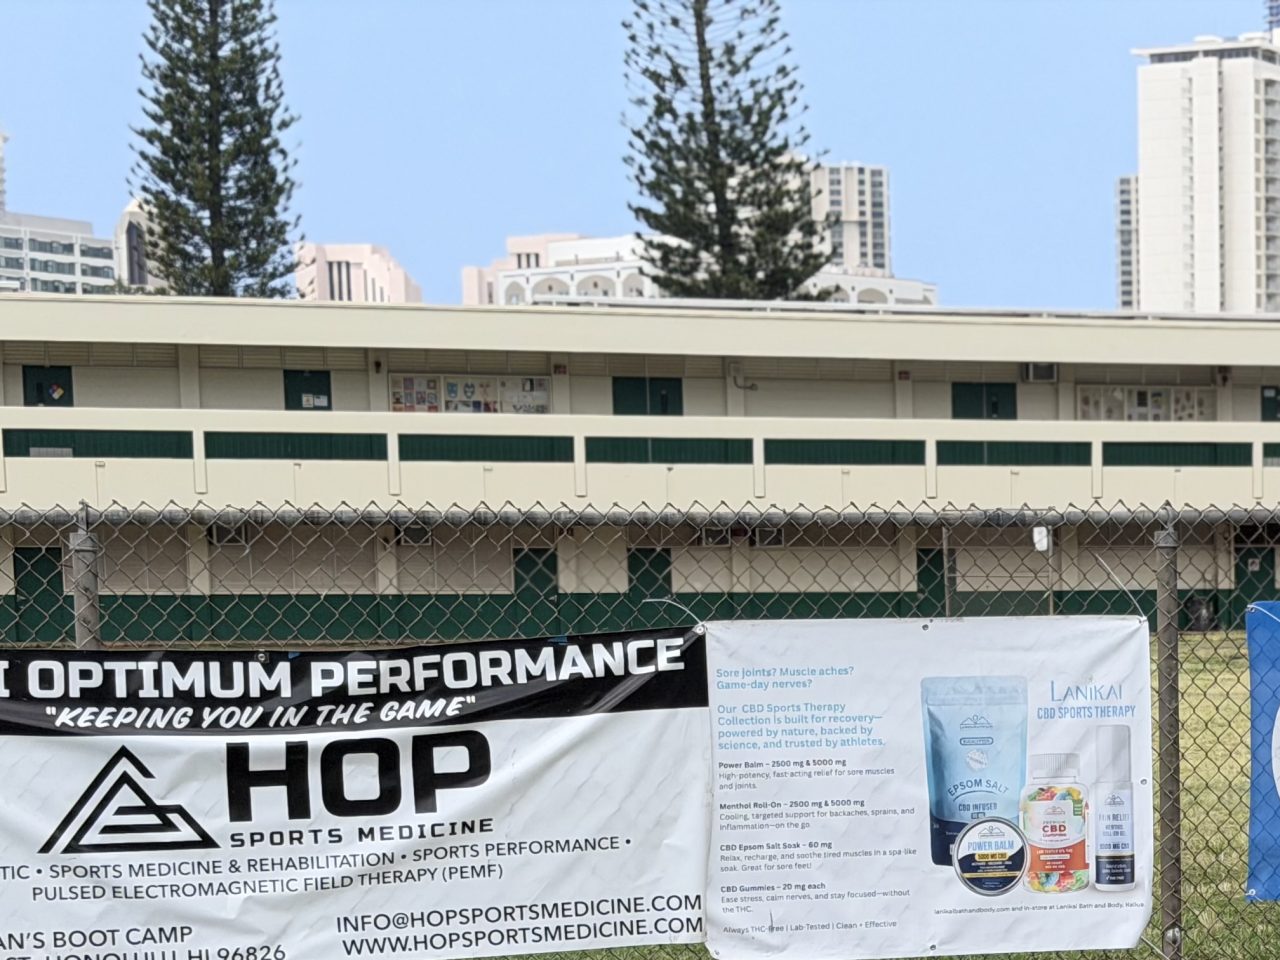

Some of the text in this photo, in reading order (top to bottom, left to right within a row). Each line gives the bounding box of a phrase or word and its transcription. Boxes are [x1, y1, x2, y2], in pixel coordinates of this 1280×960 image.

[27, 661, 292, 699] OPTIMUM
[310, 637, 685, 697] PERFORMANCE
[716, 666, 854, 679] Sore joints? Muscle aches?
[717, 679, 813, 691] Game-day nerves?
[201, 706, 263, 729] YOU
[269, 705, 309, 727] IN
[317, 701, 374, 725] THE
[717, 703, 846, 714] Our CBD Sports Therapy
[1037, 705, 1136, 720] CBD SPORTS THERAPY
[718, 716, 771, 726] Collection
[774, 715, 782, 724] is
[785, 714, 808, 724] built
[811, 714, 827, 723] for
[718, 725, 873, 740] powered by nature, backed by
[718, 741, 761, 750] science,
[763, 739, 782, 749] and
[785, 738, 822, 748] trusted
[826, 738, 838, 749] by
[745, 761, 764, 769] Balm
[772, 760, 791, 768] 2500
[225, 729, 491, 823] HOP
[948, 779, 1009, 797] EPSOM SALT
[752, 812, 783, 820] targeted
[785, 811, 815, 819] support
[230, 818, 494, 849] SPORTS MEDICINE
[1042, 825, 1066, 833] CBD
[739, 844, 764, 852] Epsom
[766, 842, 781, 850] Salt
[49, 863, 123, 880] SPORTS
[129, 859, 222, 878] MEDICINE
[228, 858, 242, 874] &
[247, 852, 395, 873] REHABILITATION
[412, 844, 480, 863] SPORTS
[485, 836, 621, 859] PERFORMANCE
[780, 852, 795, 860] and
[797, 851, 822, 859] soothe
[824, 851, 841, 859] tired
[32, 864, 504, 902] PULSED ELECTROMAGNETIC FIELD THERAPY (PEMF)
[815, 892, 829, 900] and
[336, 894, 702, 934] INFO@HOPSPORTSMEDICINE.COM
[53, 929, 120, 949] BOOT
[125, 925, 193, 946] CAMP
[342, 916, 703, 957] WWW.HOPSPORTSMEDICINE.COM
